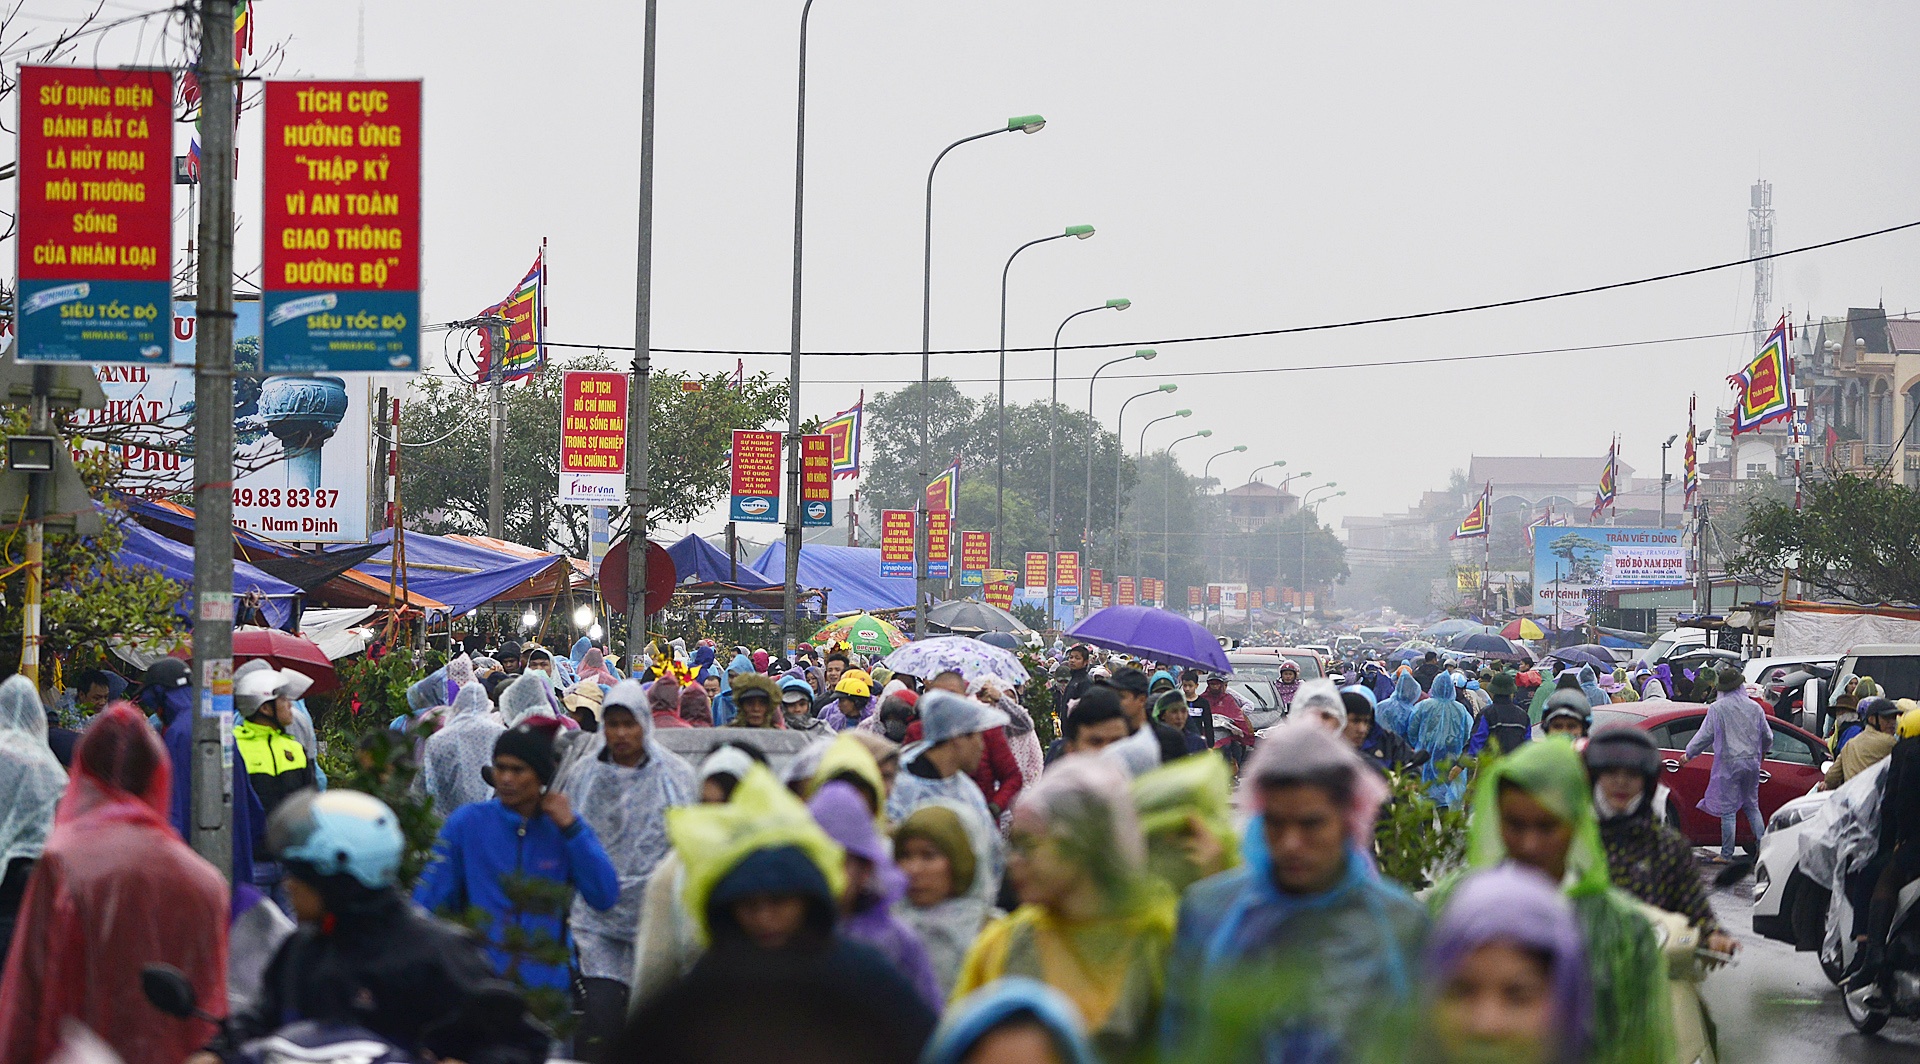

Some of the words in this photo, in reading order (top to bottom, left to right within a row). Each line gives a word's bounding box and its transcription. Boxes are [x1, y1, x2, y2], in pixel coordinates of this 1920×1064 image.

[40, 84, 66, 106] SỬ
[69, 86, 110, 108] DỤNG
[114, 87, 153, 110] ĐIỆN
[297, 90, 343, 113] TÍCH
[347, 91, 389, 117] CỰC
[43, 116, 88, 137] ĐÁNH
[92, 117, 123, 138] BẮT
[127, 116, 149, 139] CÁ
[284, 121, 354, 147] HƯỞNG
[358, 121, 401, 147] ỨNG
[47, 147, 66, 169] LÀ
[70, 146, 102, 170] HỦY
[106, 152, 144, 173] HOẠI
[363, 154, 391, 181] KỶ
[46, 178, 77, 201] MÔI
[81, 178, 145, 202] TRƯỜNG
[285, 189, 307, 215] VÌ
[310, 195, 340, 215] AN
[346, 190, 399, 216] TOÀN
[73, 208, 117, 233] SỐNG
[282, 229, 330, 249] GIAO
[334, 226, 402, 250] THÔNG
[34, 240, 66, 265] CỦA
[69, 241, 116, 266] NHÂN
[120, 248, 156, 271] LOẠI
[284, 259, 355, 284] ĐƯỜNG
[59, 302, 94, 318] SIÊU
[97, 299, 130, 318] TỐC
[133, 303, 158, 321] ĐỘ
[307, 312, 342, 329] SIÊU
[345, 309, 379, 329] TỐC
[381, 312, 407, 332] ĐỘ
[581, 377, 595, 393] CHỦ
[596, 381, 611, 396] TỊCH
[586, 397, 597, 412] CHÍ
[598, 400, 616, 412] MINH
[590, 413, 608, 431] SỐNG
[565, 435, 587, 449] TRONG
[588, 435, 598, 451] SỰ
[599, 435, 624, 452] NGHIỆP
[569, 450, 583, 467] CỦA
[584, 452, 607, 468] CHÚNG
[608, 455, 618, 468] TA.
[287, 488, 310, 508] 83
[315, 489, 339, 508] 87
[262, 516, 298, 531] Nam
[302, 517, 338, 536] Định
[1632, 556, 1643, 568] BÒ
[1644, 558, 1662, 568] NAM
[1662, 558, 1682, 570] ĐỊNH
